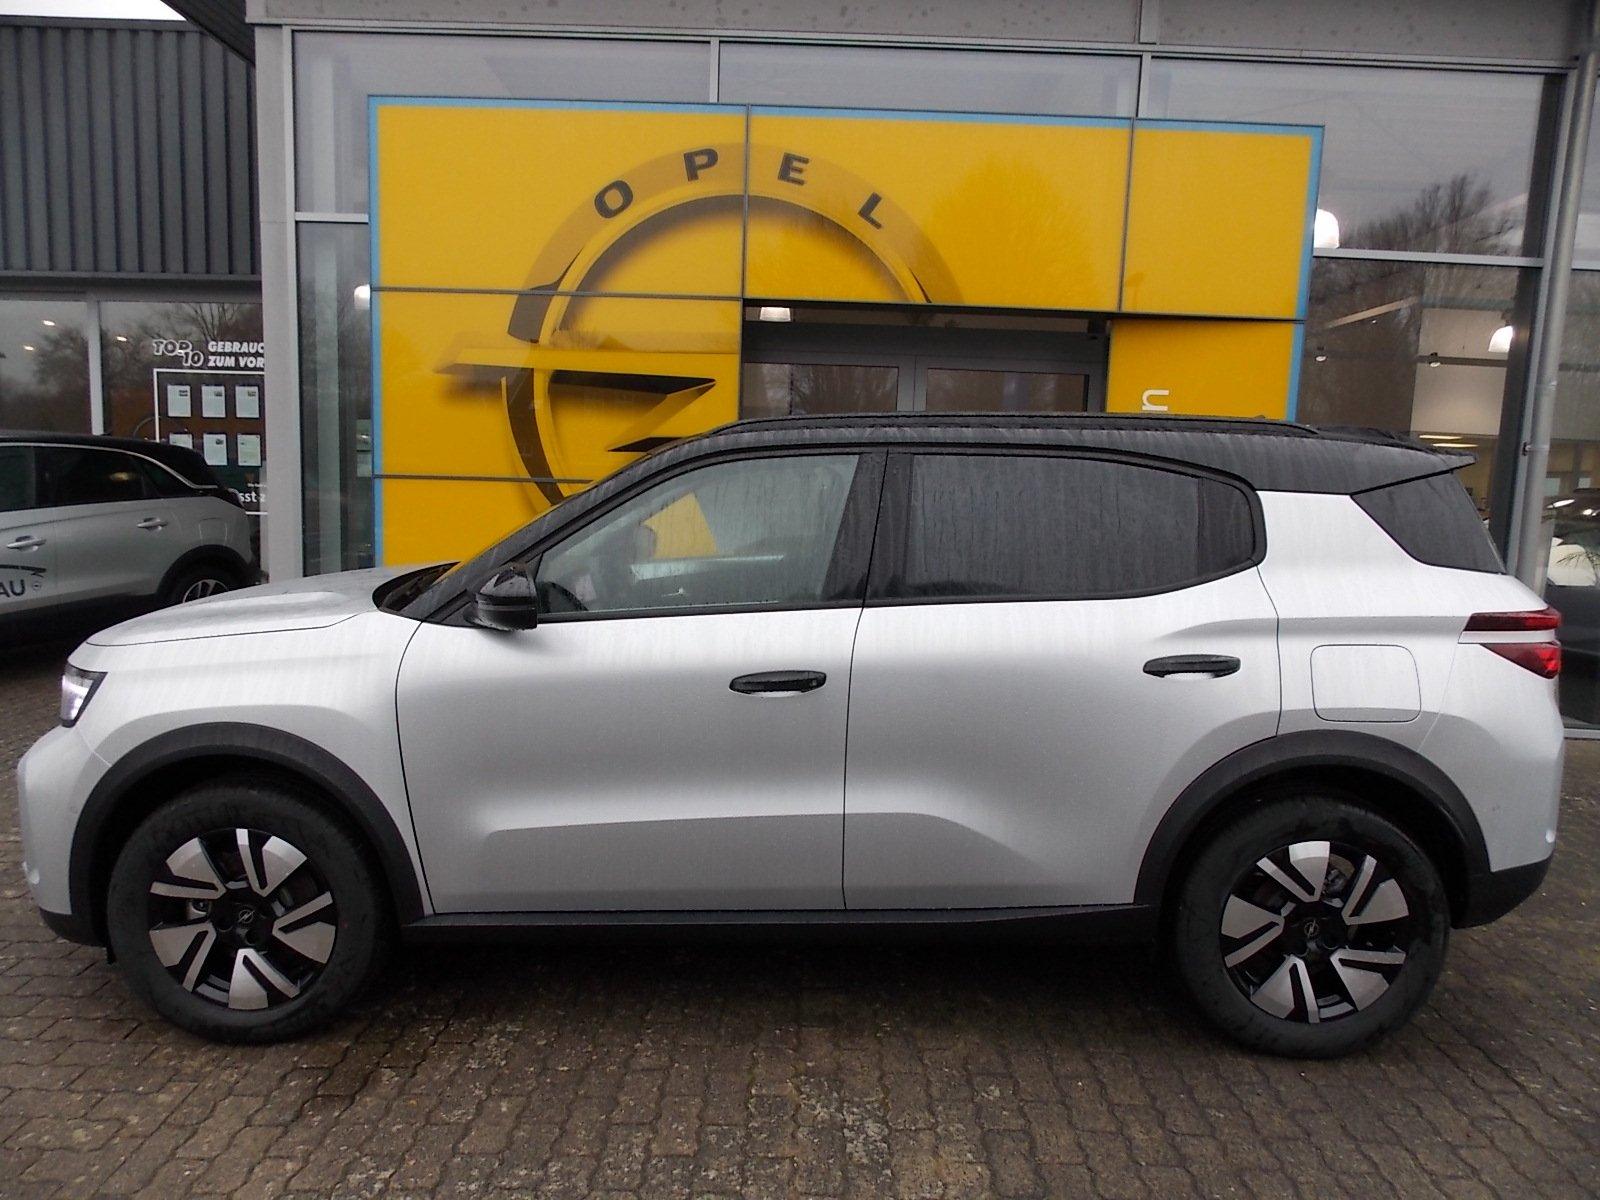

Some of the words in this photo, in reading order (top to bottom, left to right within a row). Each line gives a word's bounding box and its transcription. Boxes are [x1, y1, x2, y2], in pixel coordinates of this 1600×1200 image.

[594, 148, 882, 230] OPEL
[153, 339, 192, 356] TOP
[182, 350, 204, 366] 10
[207, 355, 235, 367] ZUM
[239, 356, 264, 368] VOR
